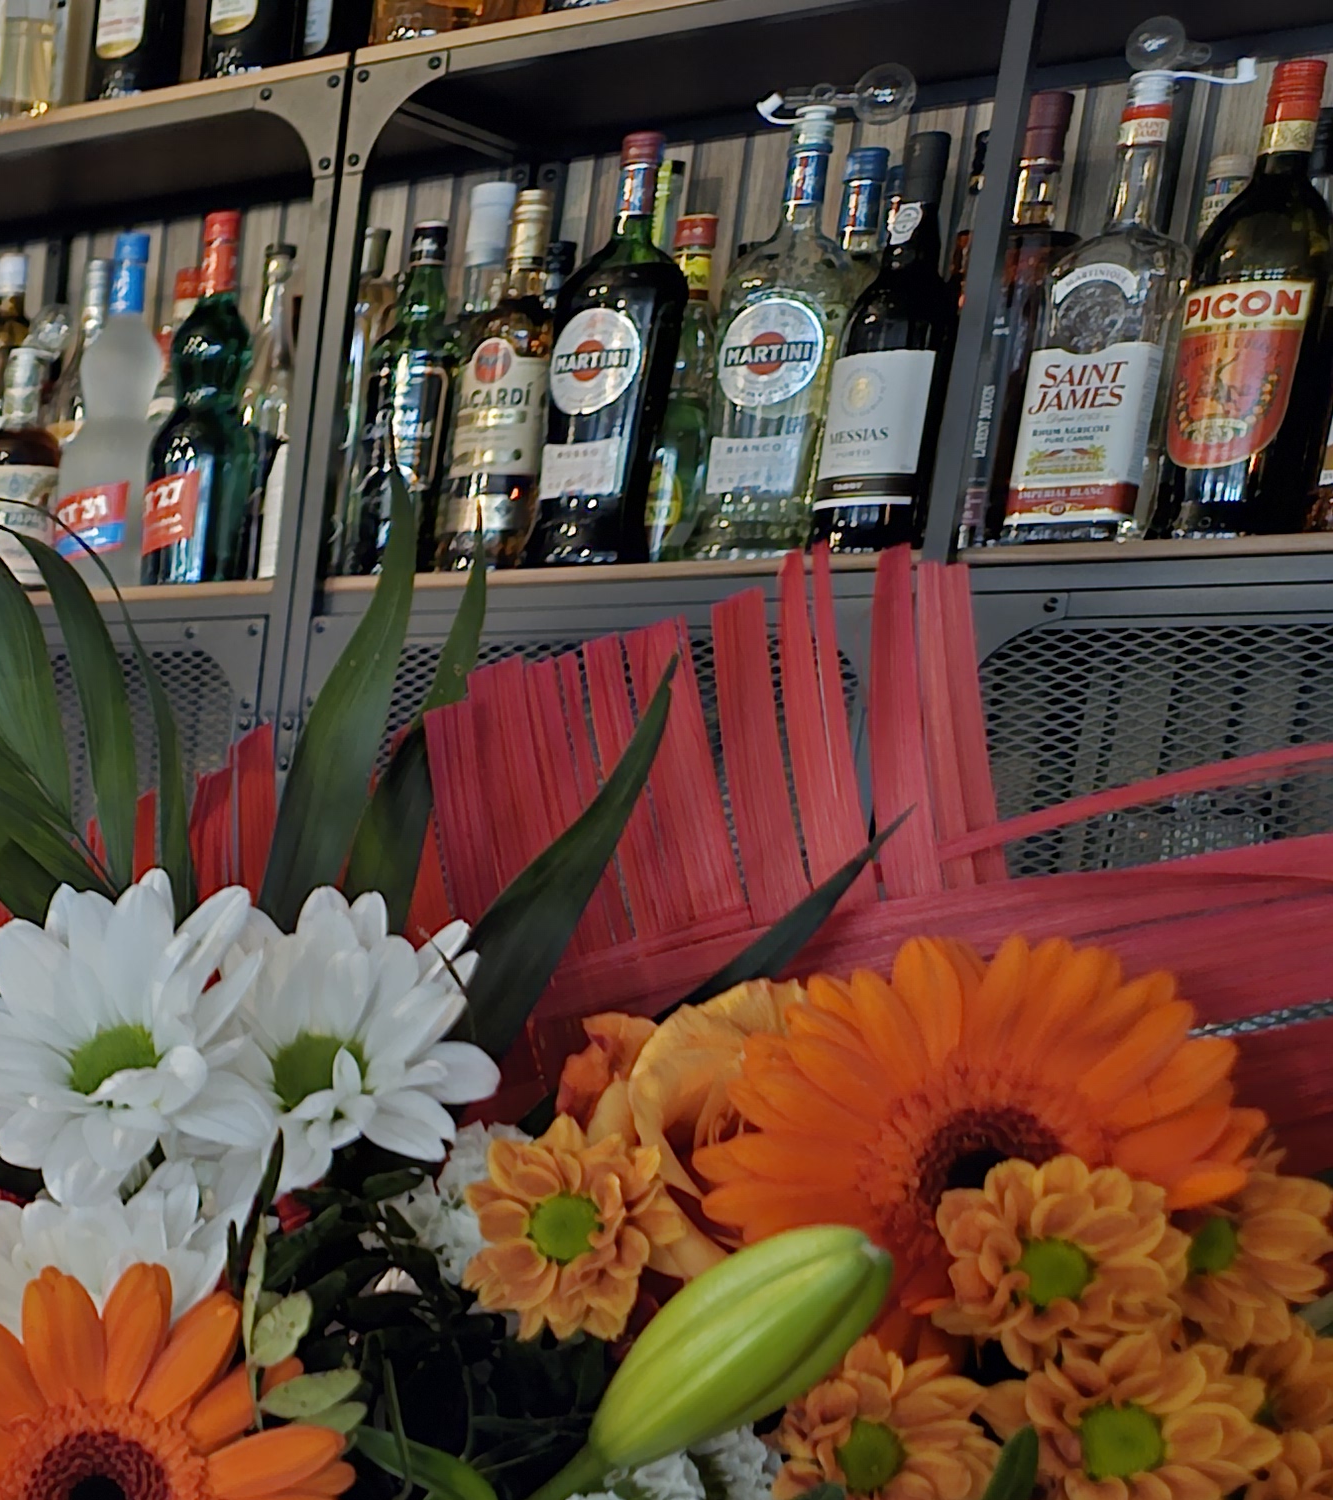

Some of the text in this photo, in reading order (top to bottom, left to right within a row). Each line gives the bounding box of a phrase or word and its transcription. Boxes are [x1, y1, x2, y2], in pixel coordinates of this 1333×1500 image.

[1064, 268, 1130, 289] MARTINIQUE
[1185, 289, 1303, 326] PICON
[555, 349, 631, 373] MARTINI
[726, 343, 811, 366] MARTINI
[1038, 361, 1129, 390] SAINT
[1027, 385, 1126, 416] JAMES
[829, 426, 890, 446] MESSIAS
[725, 442, 783, 455] BIANCO
[81, 494, 108, 520] 31
